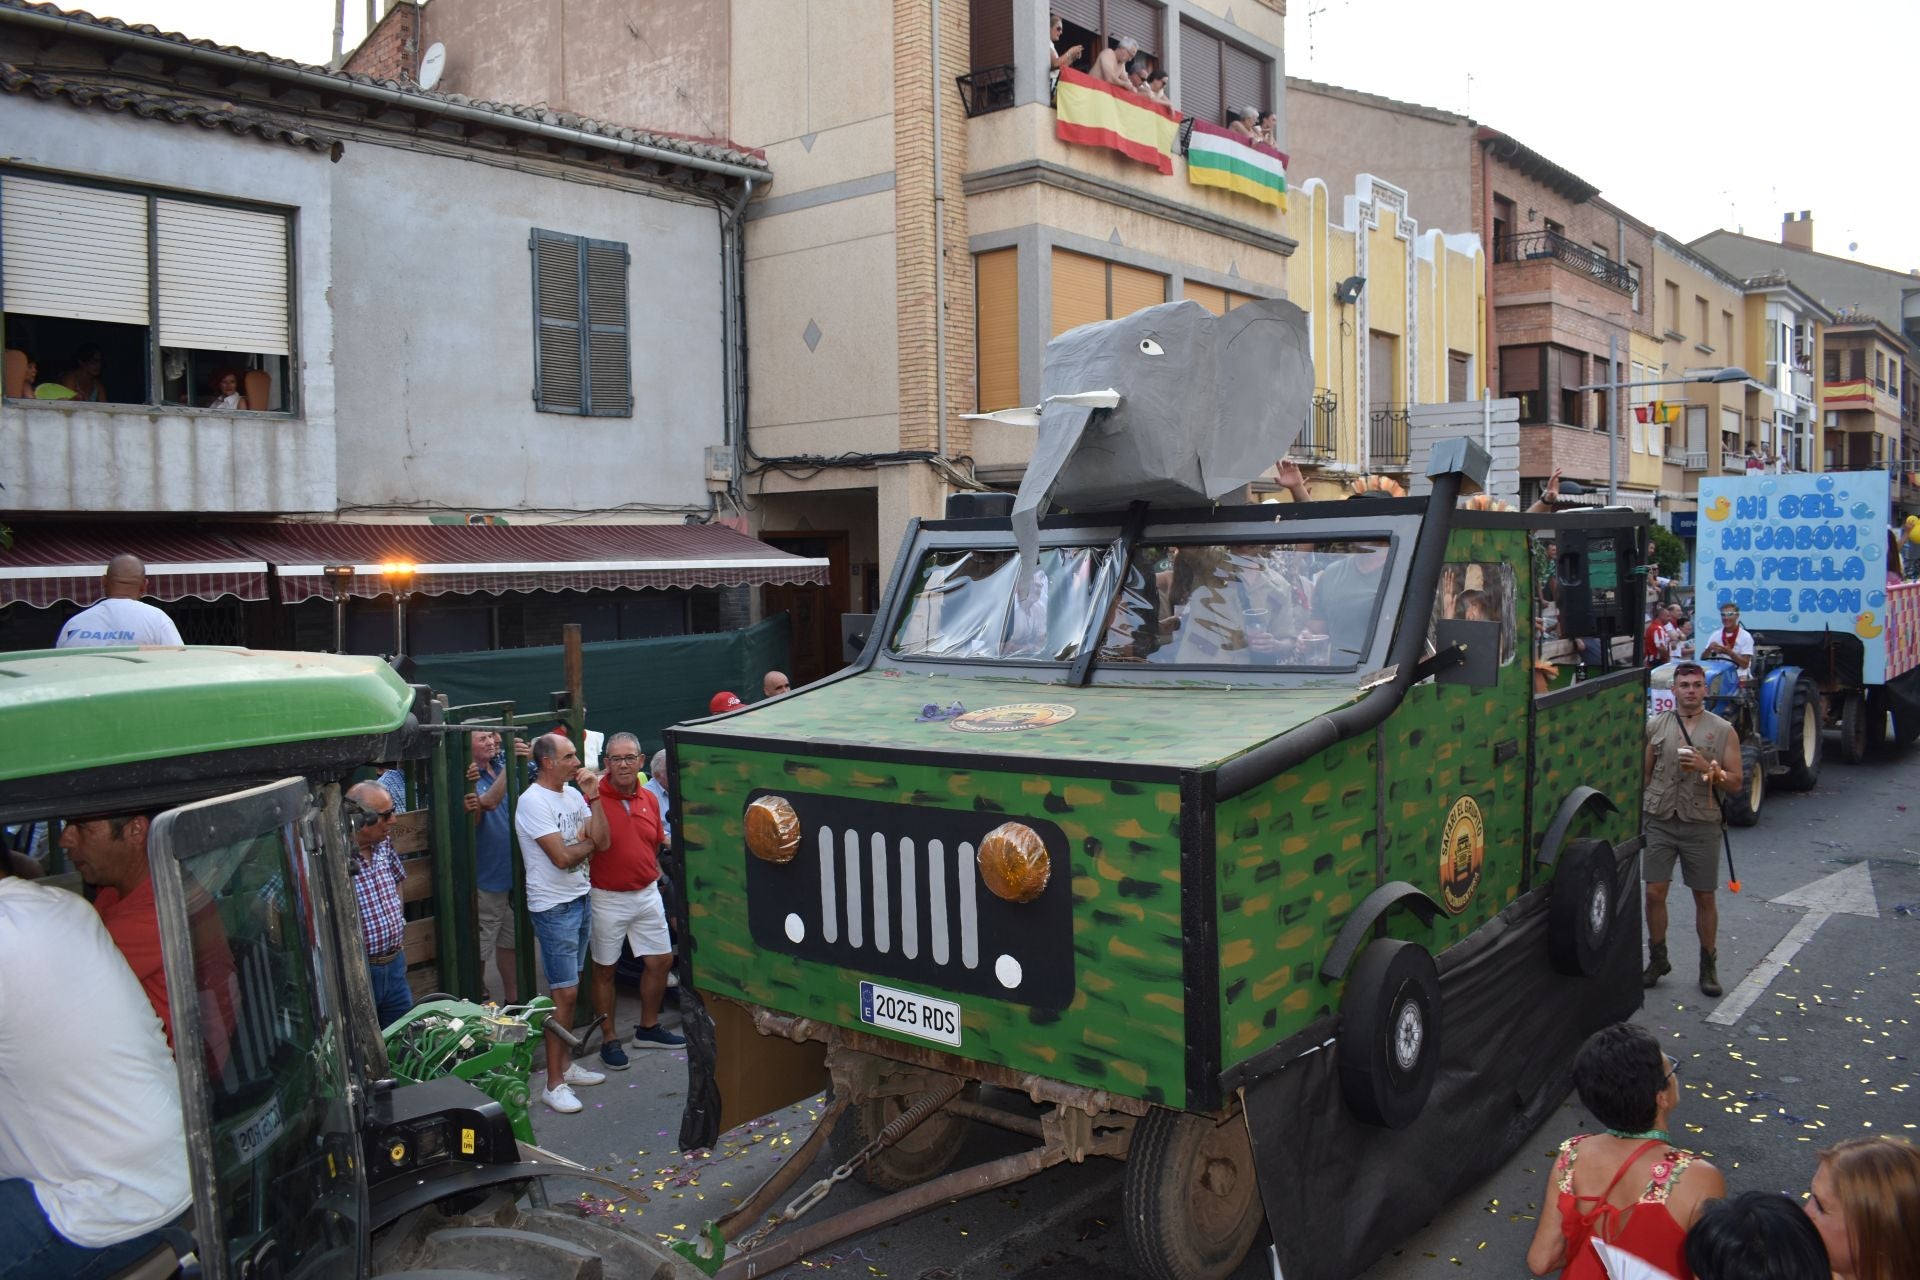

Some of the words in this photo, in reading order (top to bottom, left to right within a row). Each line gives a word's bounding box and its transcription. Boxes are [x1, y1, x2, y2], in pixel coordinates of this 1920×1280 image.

[1736, 495, 1767, 520] NI
[1778, 494, 1844, 519] GEL
[1680, 520, 1697, 528] BBV
[1721, 527, 1752, 550] NI
[1713, 556, 1755, 581] LA
[1761, 556, 1866, 581] PELLA
[1716, 588, 1792, 612] BEBE
[1799, 588, 1861, 613] RON
[80, 630, 135, 641] DAIKIN
[1655, 698, 1673, 712] 39
[1442, 809, 1457, 857] SAFARI
[1457, 803, 1464, 817] EL
[1464, 799, 1483, 837] GRUPITO
[865, 1007, 871, 1017] E
[876, 994, 917, 1025] 2025
[923, 1005, 955, 1034] RDS
